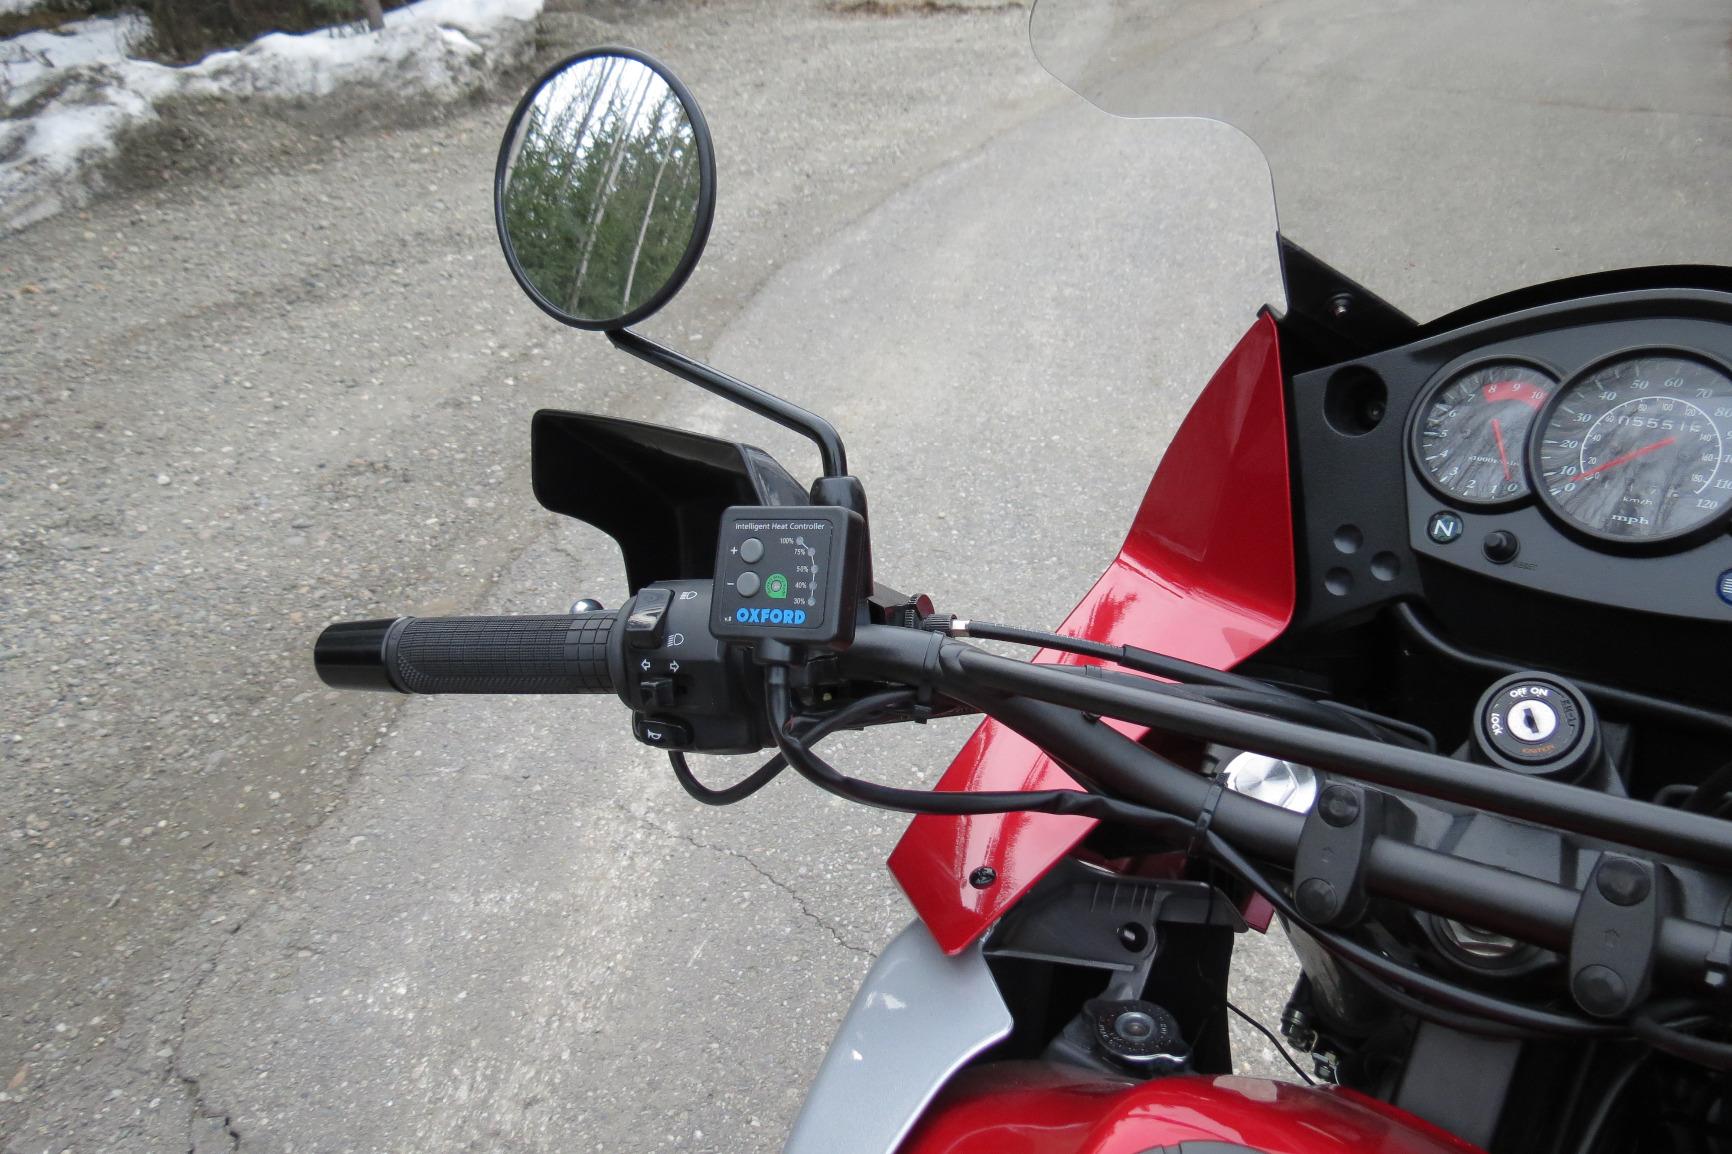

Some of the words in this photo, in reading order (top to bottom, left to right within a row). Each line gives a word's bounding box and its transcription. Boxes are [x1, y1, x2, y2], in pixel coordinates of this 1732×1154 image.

[1511, 383, 1521, 392] 9
[1630, 379, 1649, 389] 50
[1663, 378, 1684, 388] 60
[1488, 384, 1497, 393] 8
[1695, 388, 1713, 399] 70
[1467, 393, 1476, 402] 7
[1529, 391, 1544, 400] 10
[1599, 391, 1617, 400] 40
[1448, 409, 1457, 418] 6
[1573, 413, 1592, 423] 30
[1440, 430, 1449, 438] 5
[1559, 439, 1578, 449] 20
[1440, 449, 1449, 458] 4
[1449, 467, 1459, 476] 3
[1558, 465, 1577, 476] 10
[1466, 480, 1476, 489] 2
[1489, 484, 1498, 494] 1
[1507, 483, 1518, 492] 0
[1564, 482, 1576, 492] 0
[1696, 499, 1718, 510] 120
[1611, 514, 1649, 525] mph
[735, 523, 770, 531] Intelligent
[1433, 519, 1455, 537] N
[736, 607, 806, 625] OXFORD
[1510, 687, 1528, 698] OFF
[1530, 687, 1549, 697] ON
